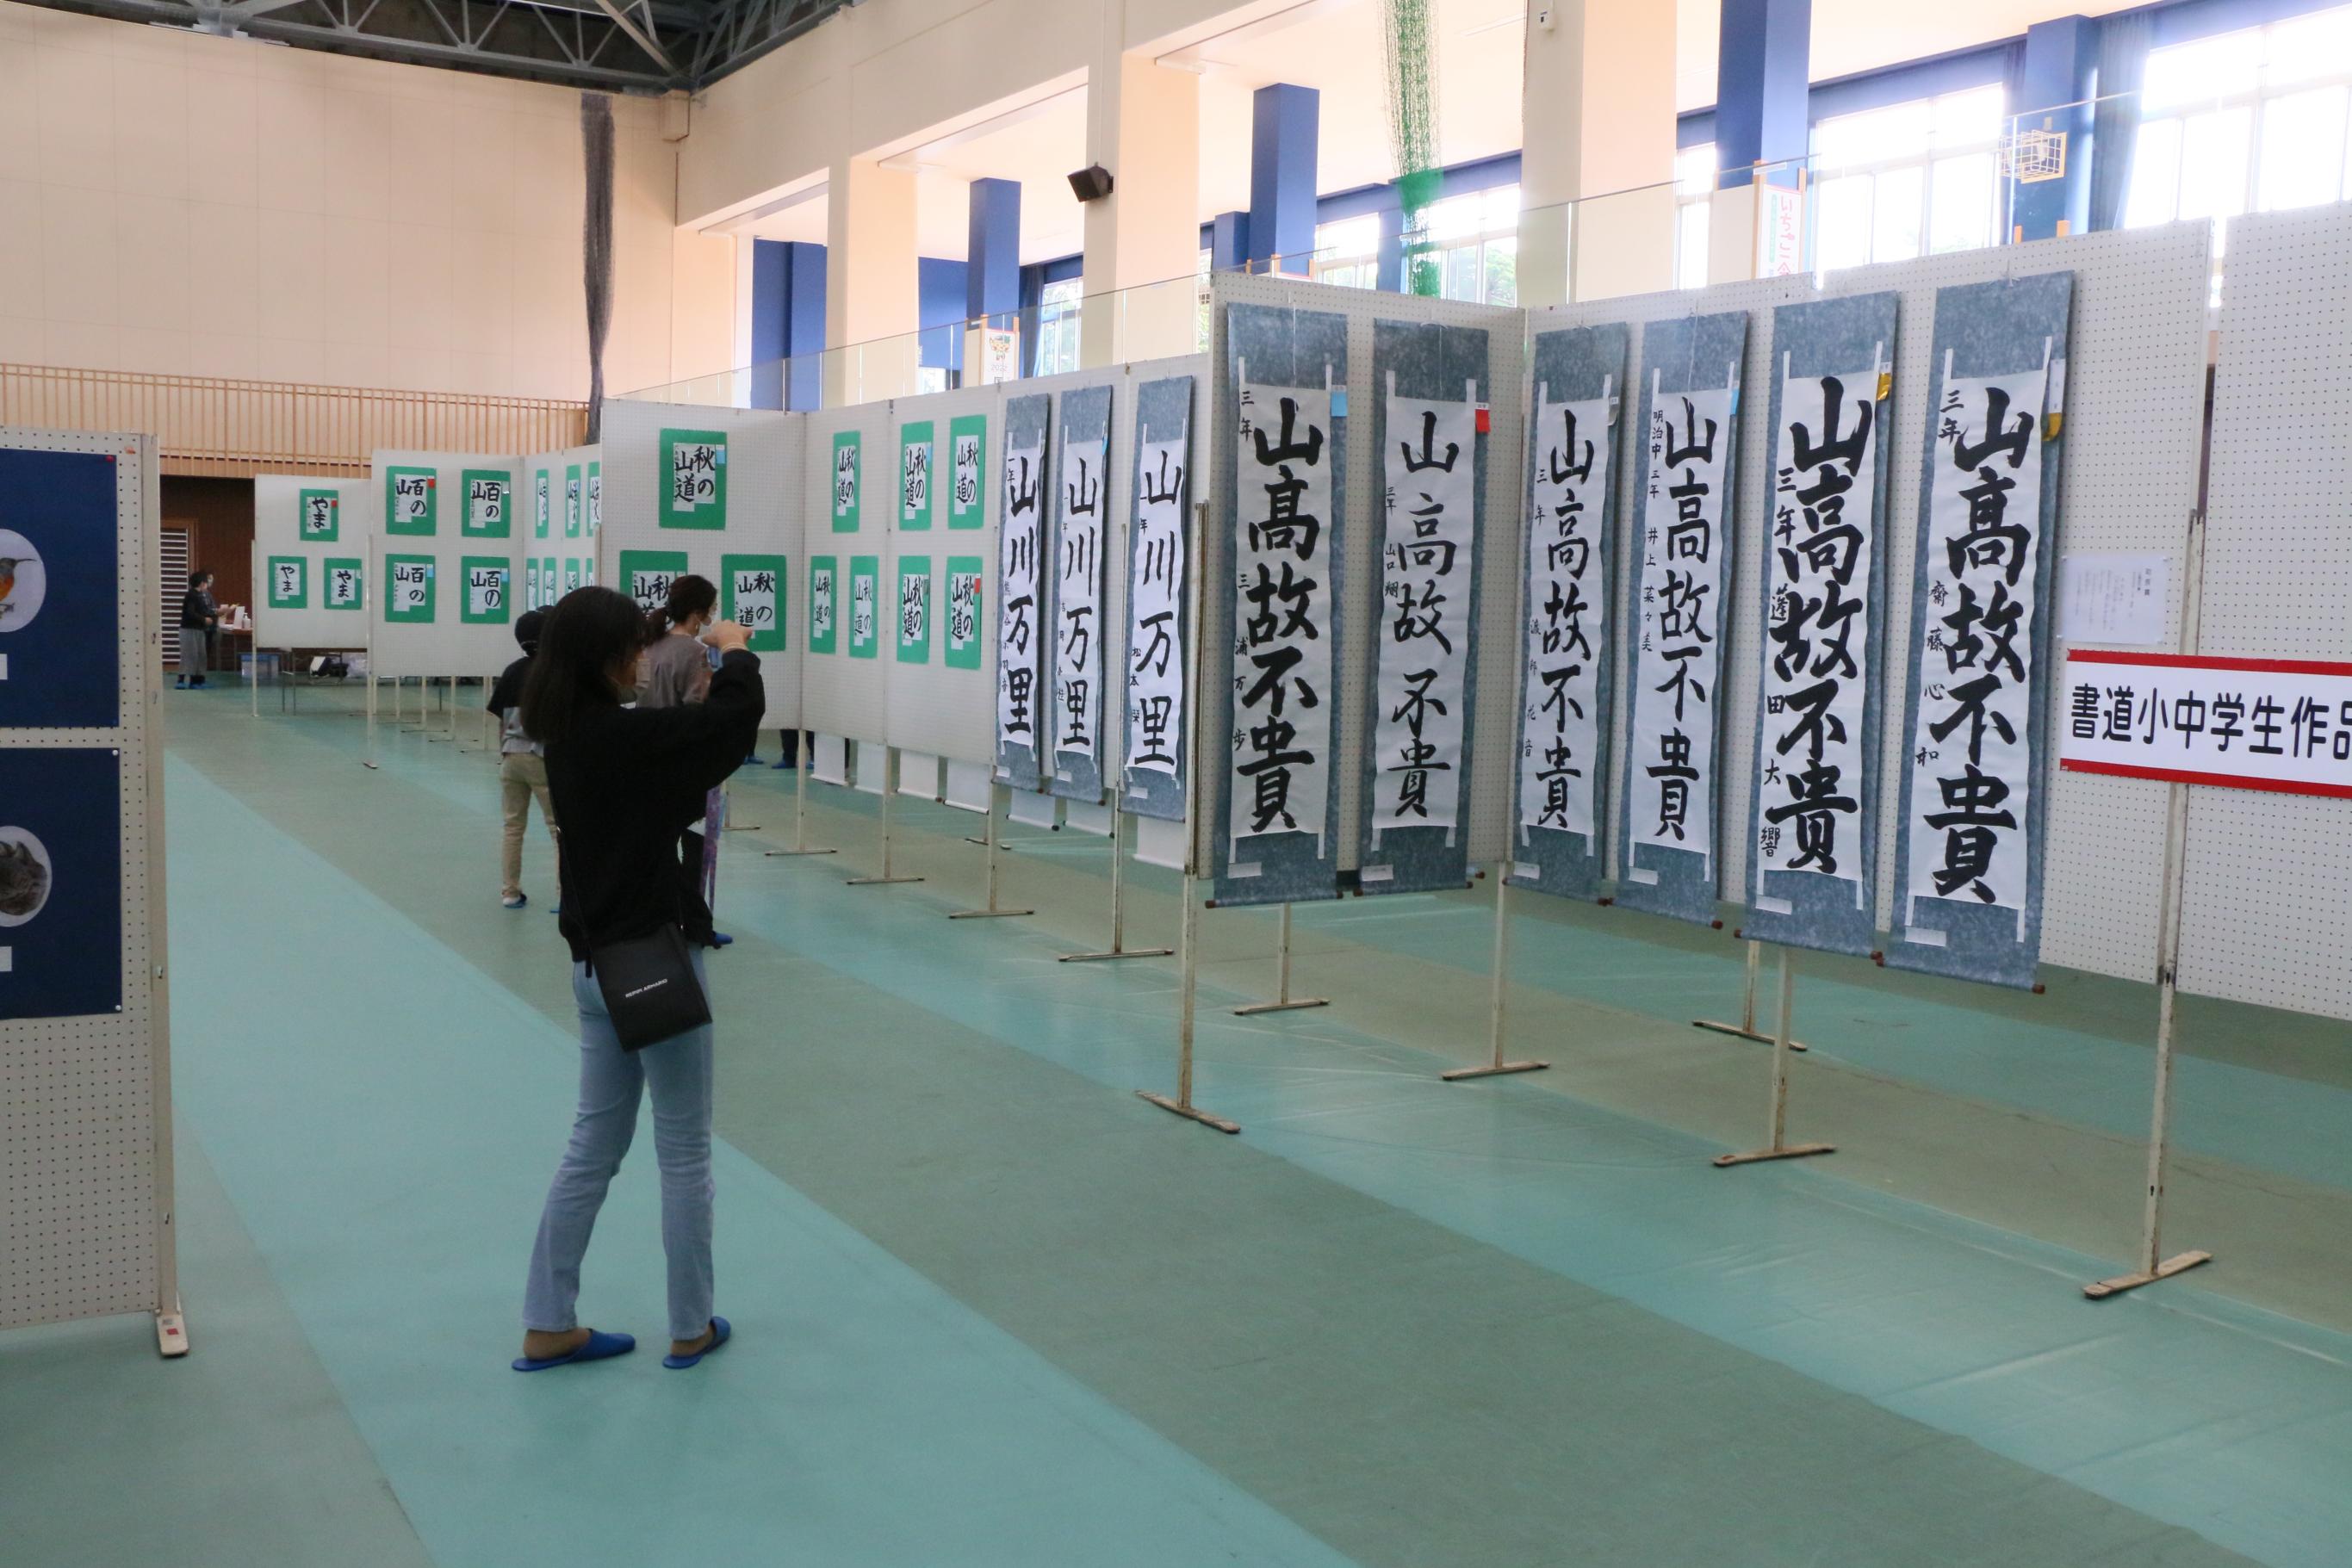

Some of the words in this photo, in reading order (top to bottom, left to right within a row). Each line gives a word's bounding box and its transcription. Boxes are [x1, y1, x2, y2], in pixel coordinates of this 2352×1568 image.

[1239, 391, 1255, 442] 三年
[1535, 468, 1548, 525] 三年
[1939, 390, 1964, 445] 三年
[280, 566, 295, 592] やま
[312, 497, 329, 529] やま
[337, 570, 352, 598] やま
[1004, 456, 1037, 734] 山川万里
[1774, 468, 1797, 546] 三年
[1063, 457, 1098, 747] 山川万里
[1134, 449, 1182, 766] 山川万里
[1387, 411, 1460, 818] 山高故不貴
[1536, 409, 1595, 828] 山高故不貴
[1646, 396, 1717, 841] 山高故不貴
[1766, 376, 1873, 874] 山高故不貴
